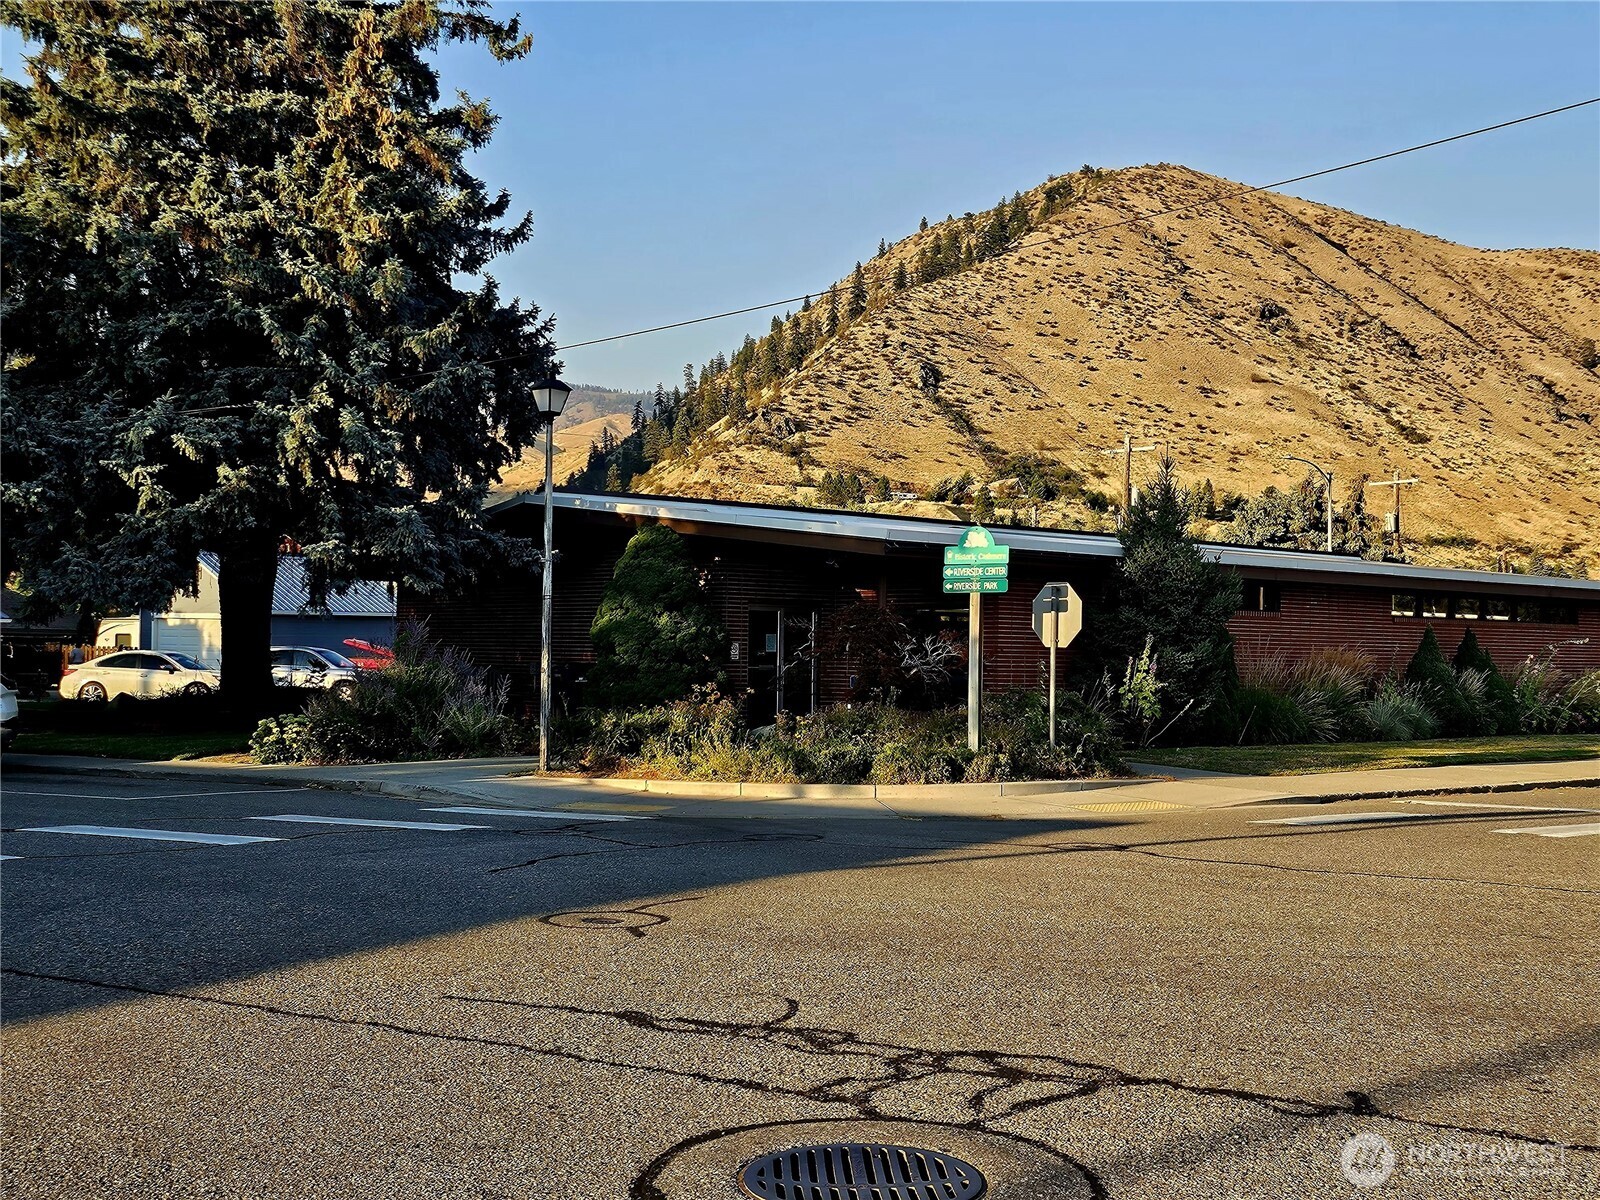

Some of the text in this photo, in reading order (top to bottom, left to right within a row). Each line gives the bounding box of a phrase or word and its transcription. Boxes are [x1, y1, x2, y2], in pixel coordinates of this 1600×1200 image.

[954, 567, 1007, 576] RIVERSIDE CENTER
[953, 581, 998, 591] RIVERSIDE PARK
